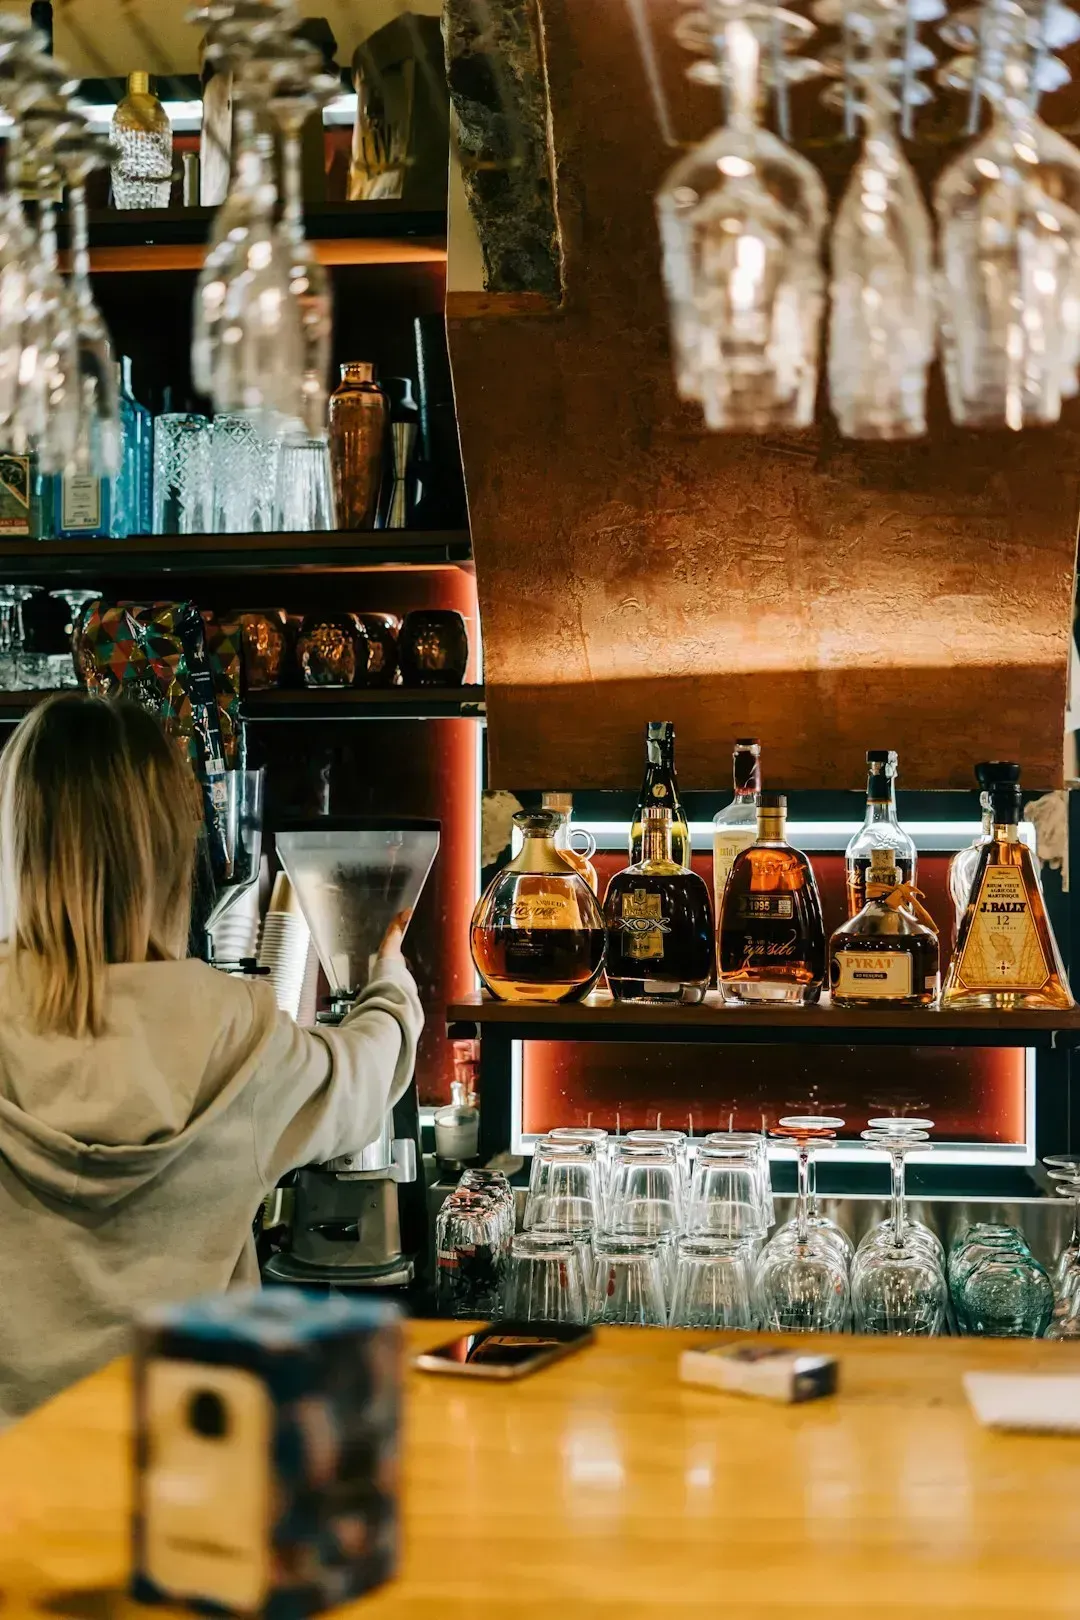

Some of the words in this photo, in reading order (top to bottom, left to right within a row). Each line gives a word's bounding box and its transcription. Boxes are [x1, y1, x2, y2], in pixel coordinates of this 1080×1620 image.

[749, 901, 770, 910] 1995
[996, 915, 1010, 926] 12
[845, 957, 895, 969] PYRAT
